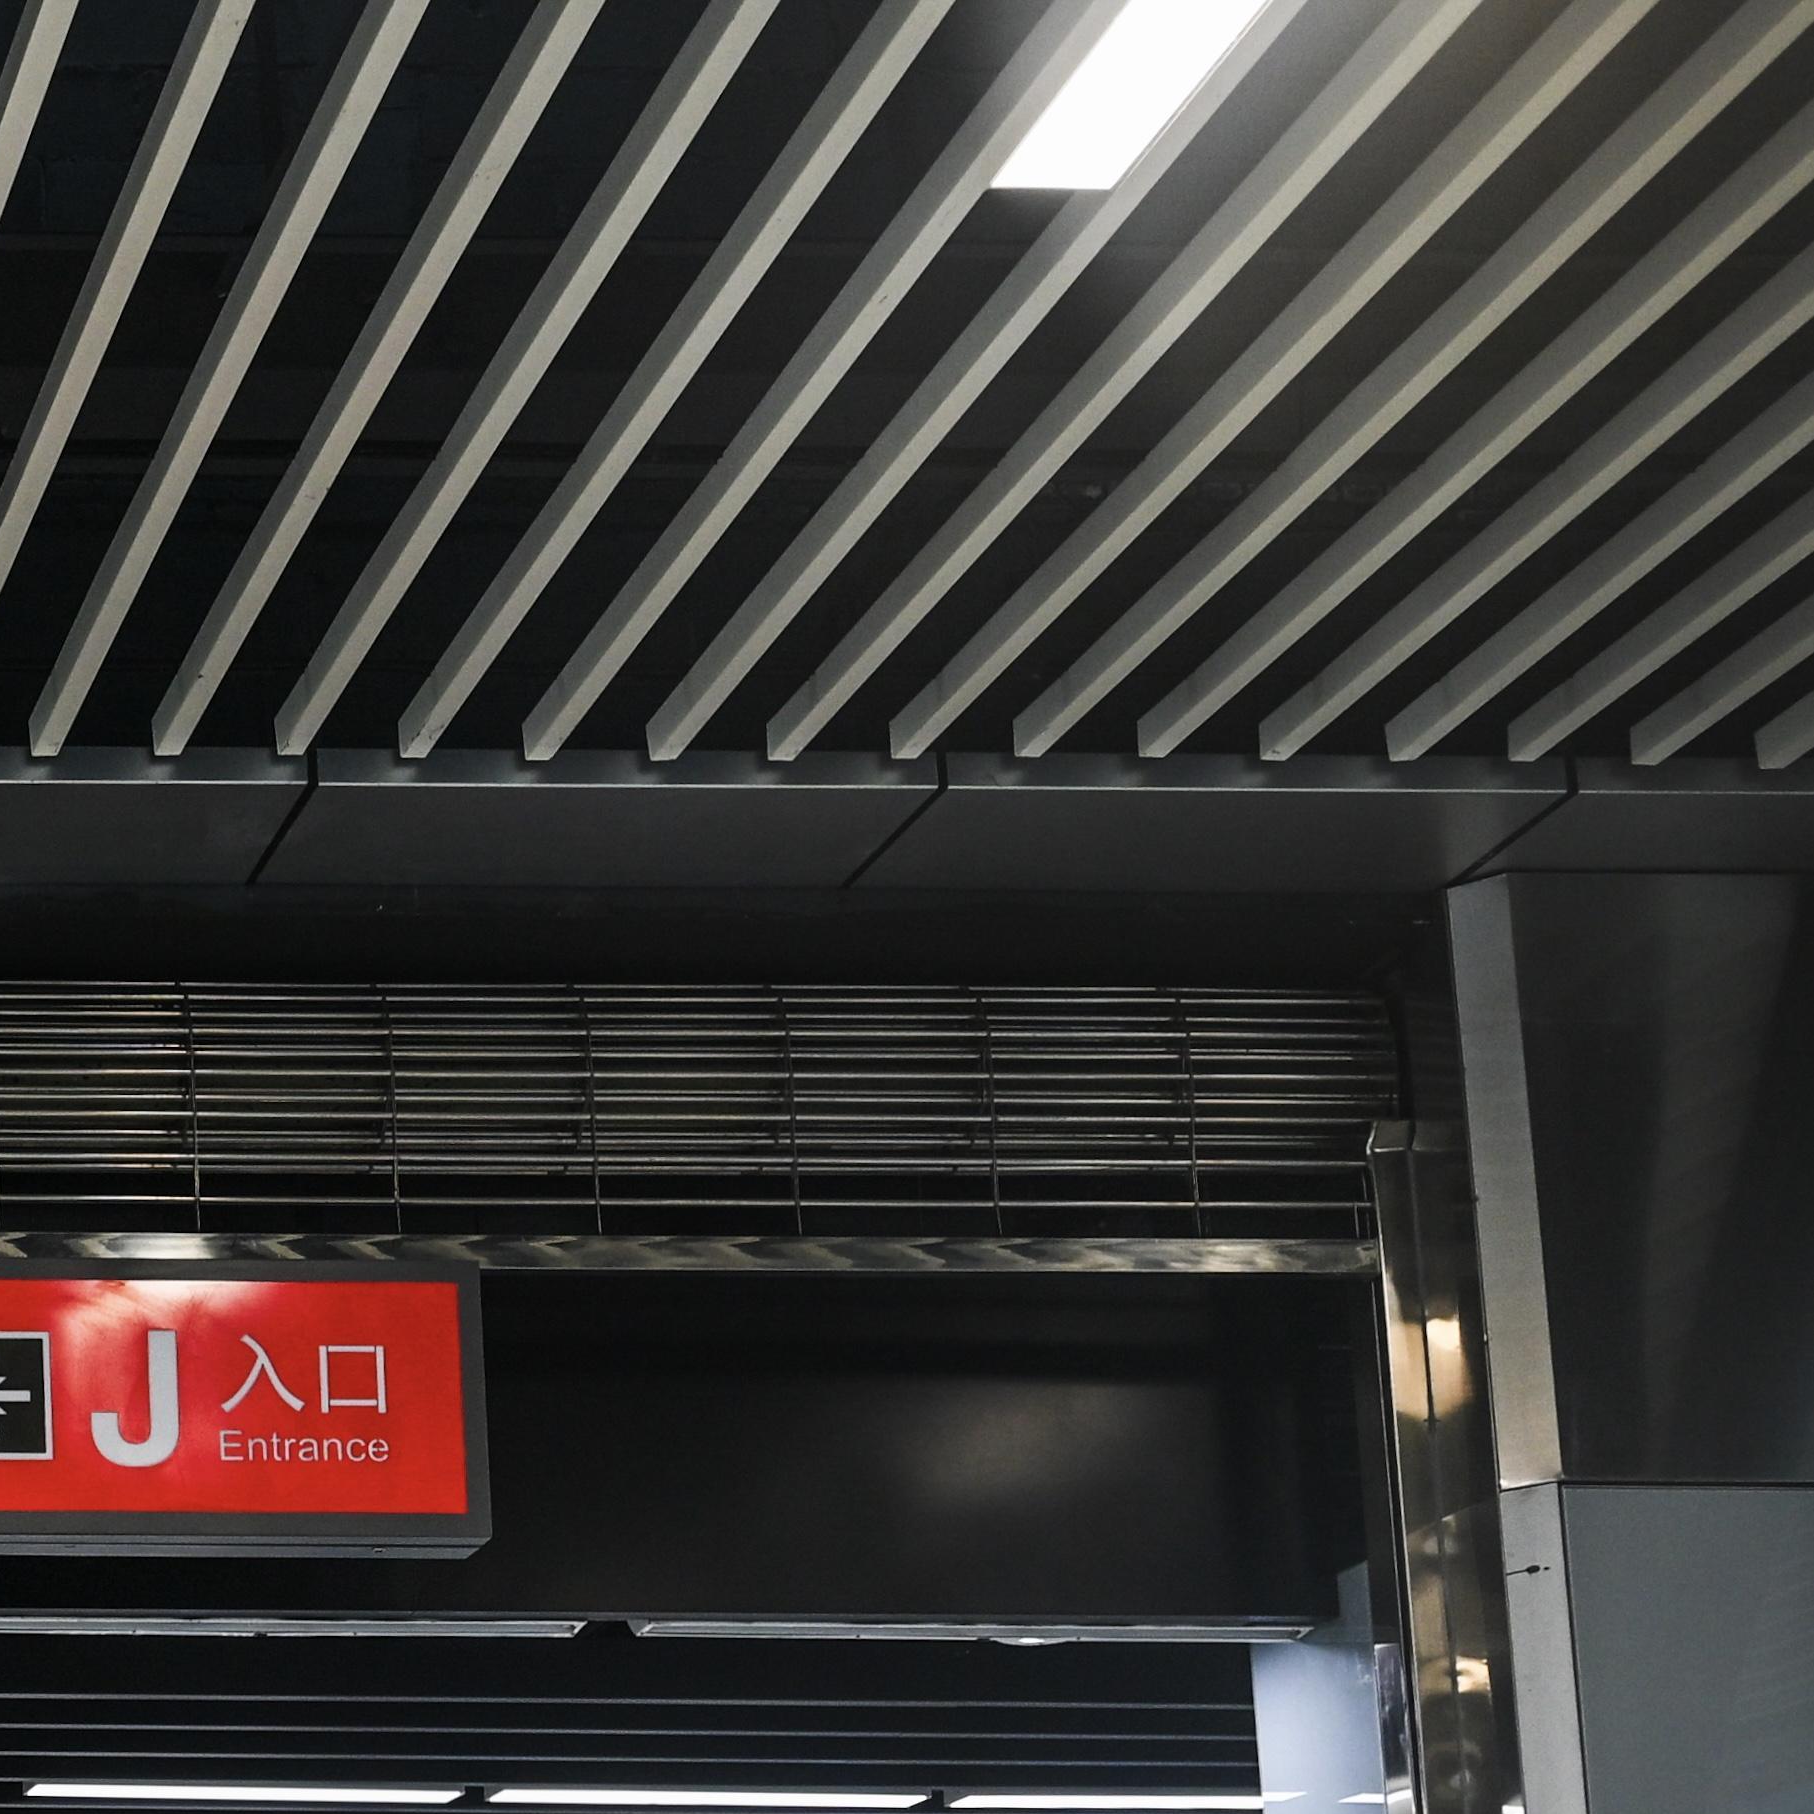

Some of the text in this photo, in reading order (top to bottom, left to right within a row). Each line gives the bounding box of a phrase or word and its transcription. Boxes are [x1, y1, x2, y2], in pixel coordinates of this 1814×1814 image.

[90, 1330, 180, 1467] J
[220, 1333, 389, 1413] 入口
[219, 1429, 390, 1463] Entrance
